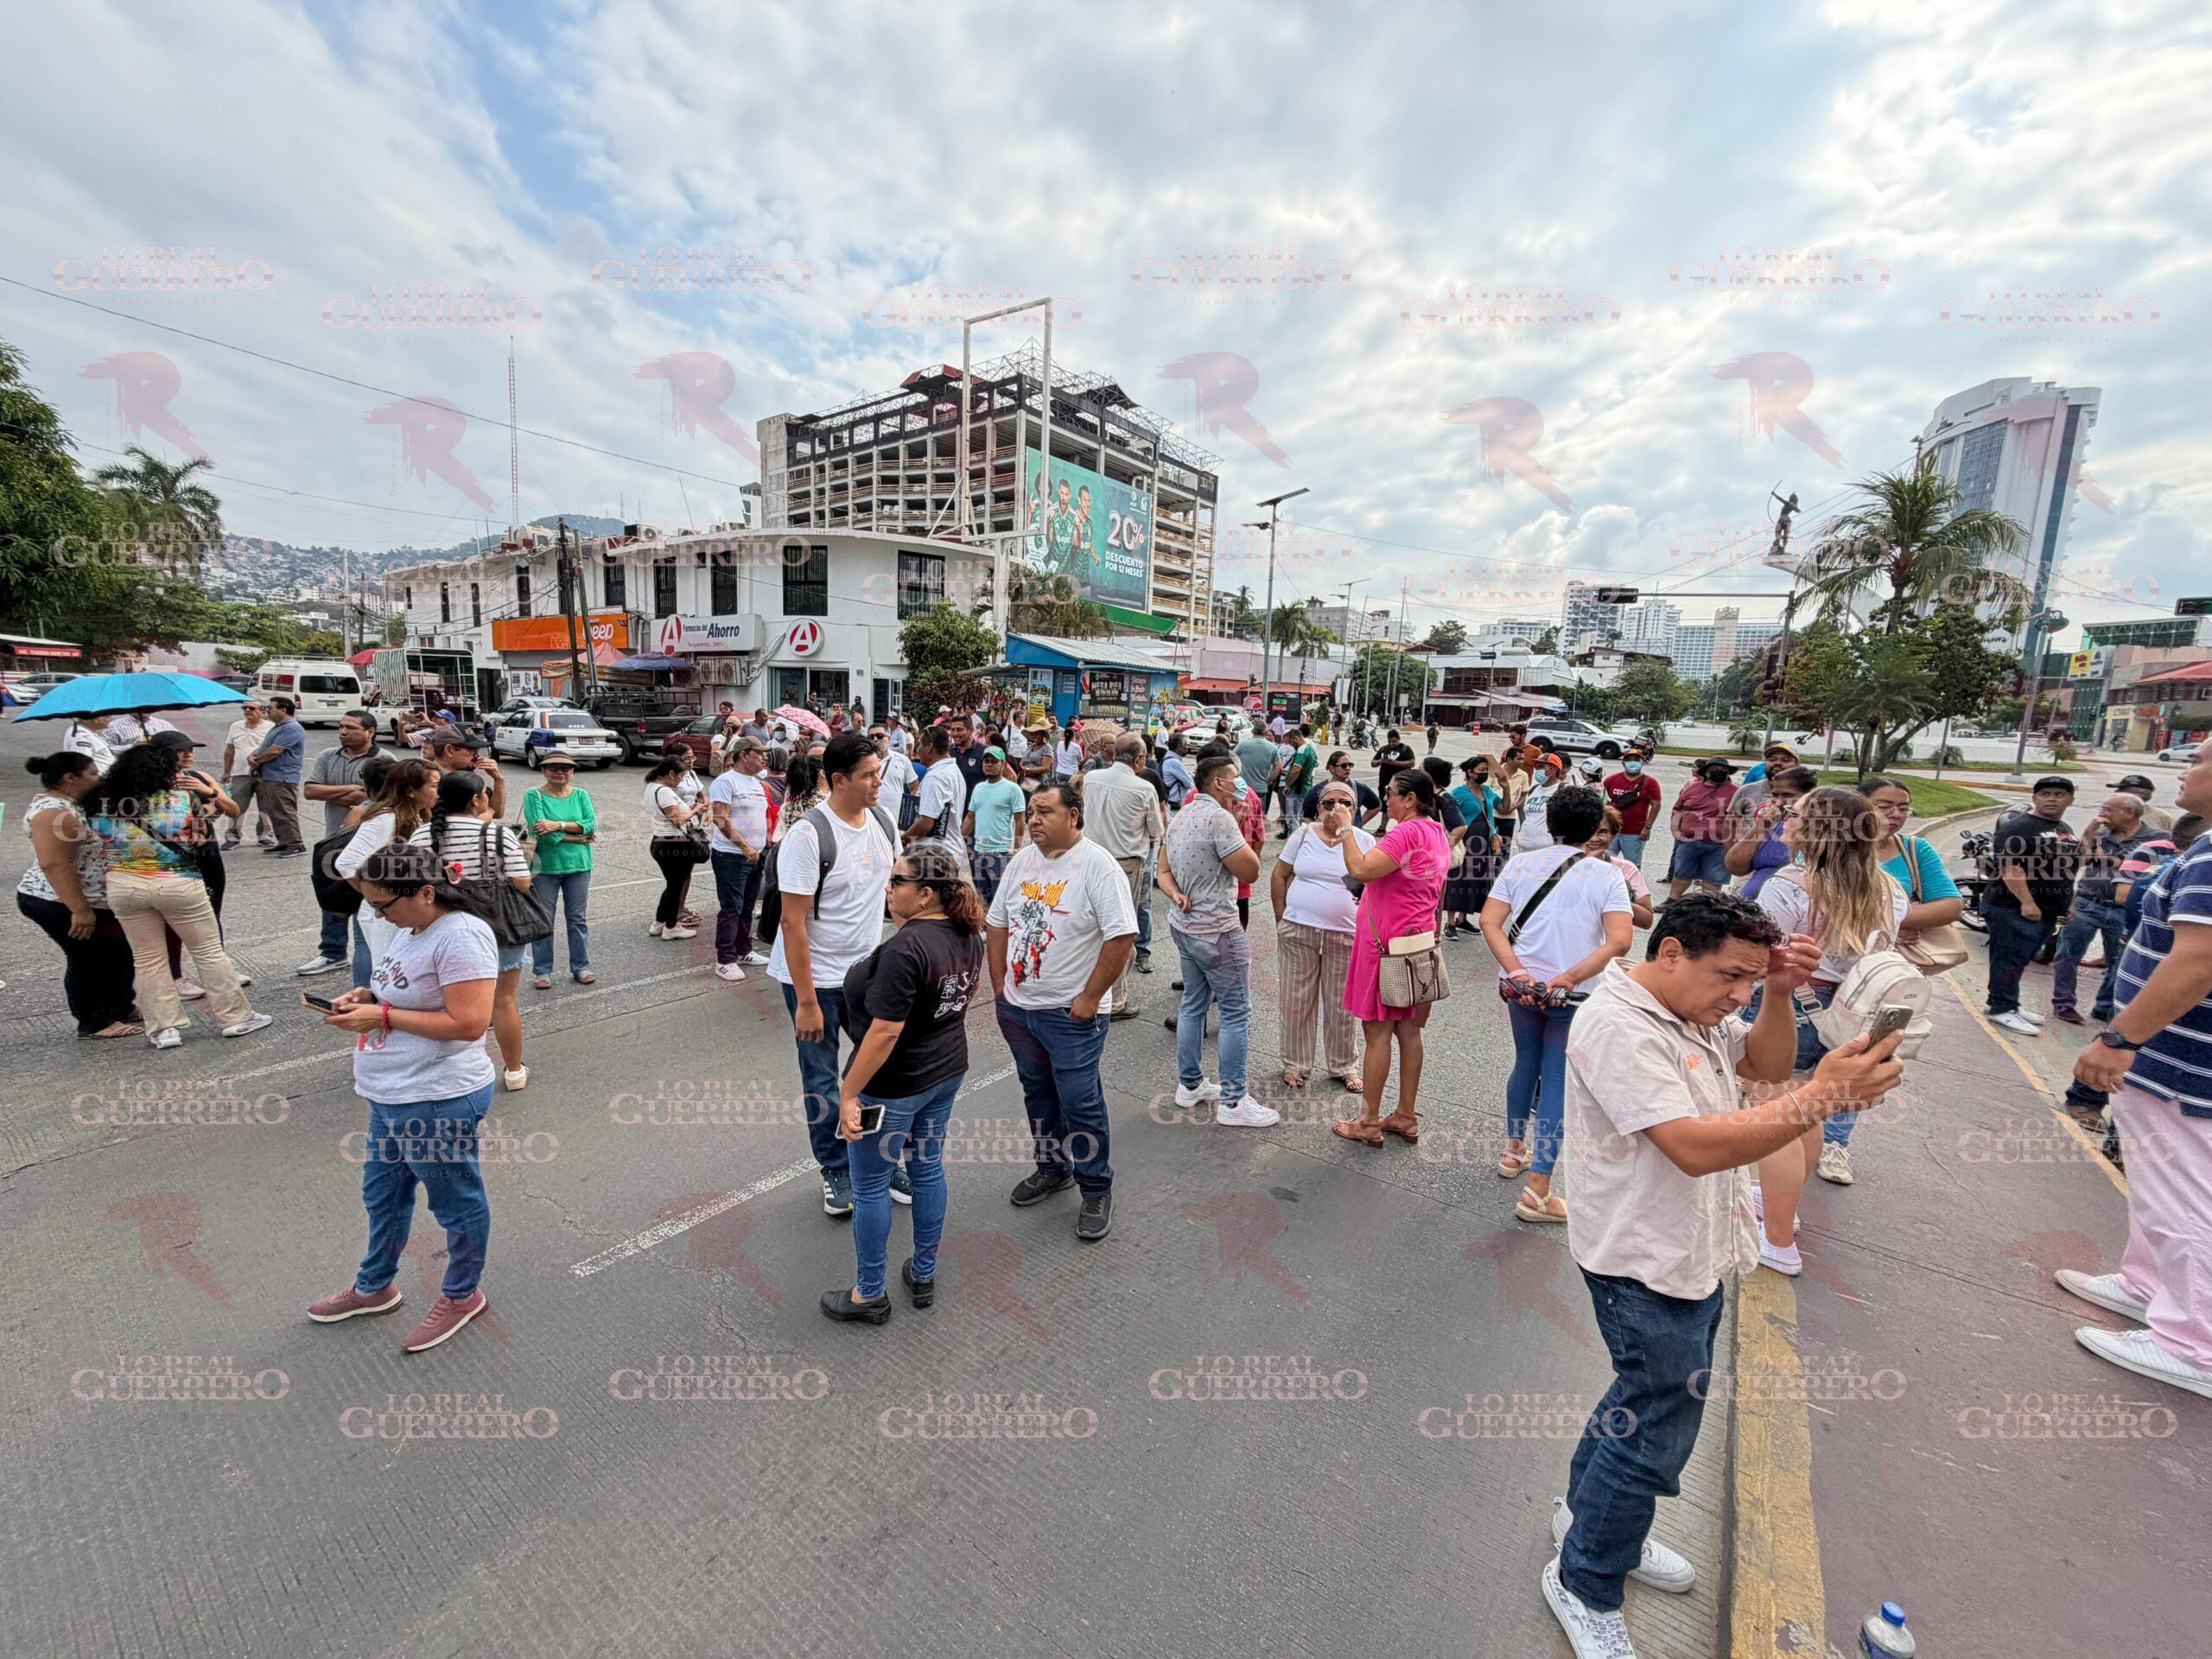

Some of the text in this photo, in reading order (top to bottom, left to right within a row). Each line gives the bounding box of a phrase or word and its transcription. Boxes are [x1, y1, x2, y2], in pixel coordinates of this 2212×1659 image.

[1107, 510, 1145, 551] 20%
[1104, 561, 1144, 577] POR 12 MESES
[1105, 550, 1144, 569] DESCUENTO
[707, 622, 740, 638] Ahorro
[389, 961, 410, 990] AND
